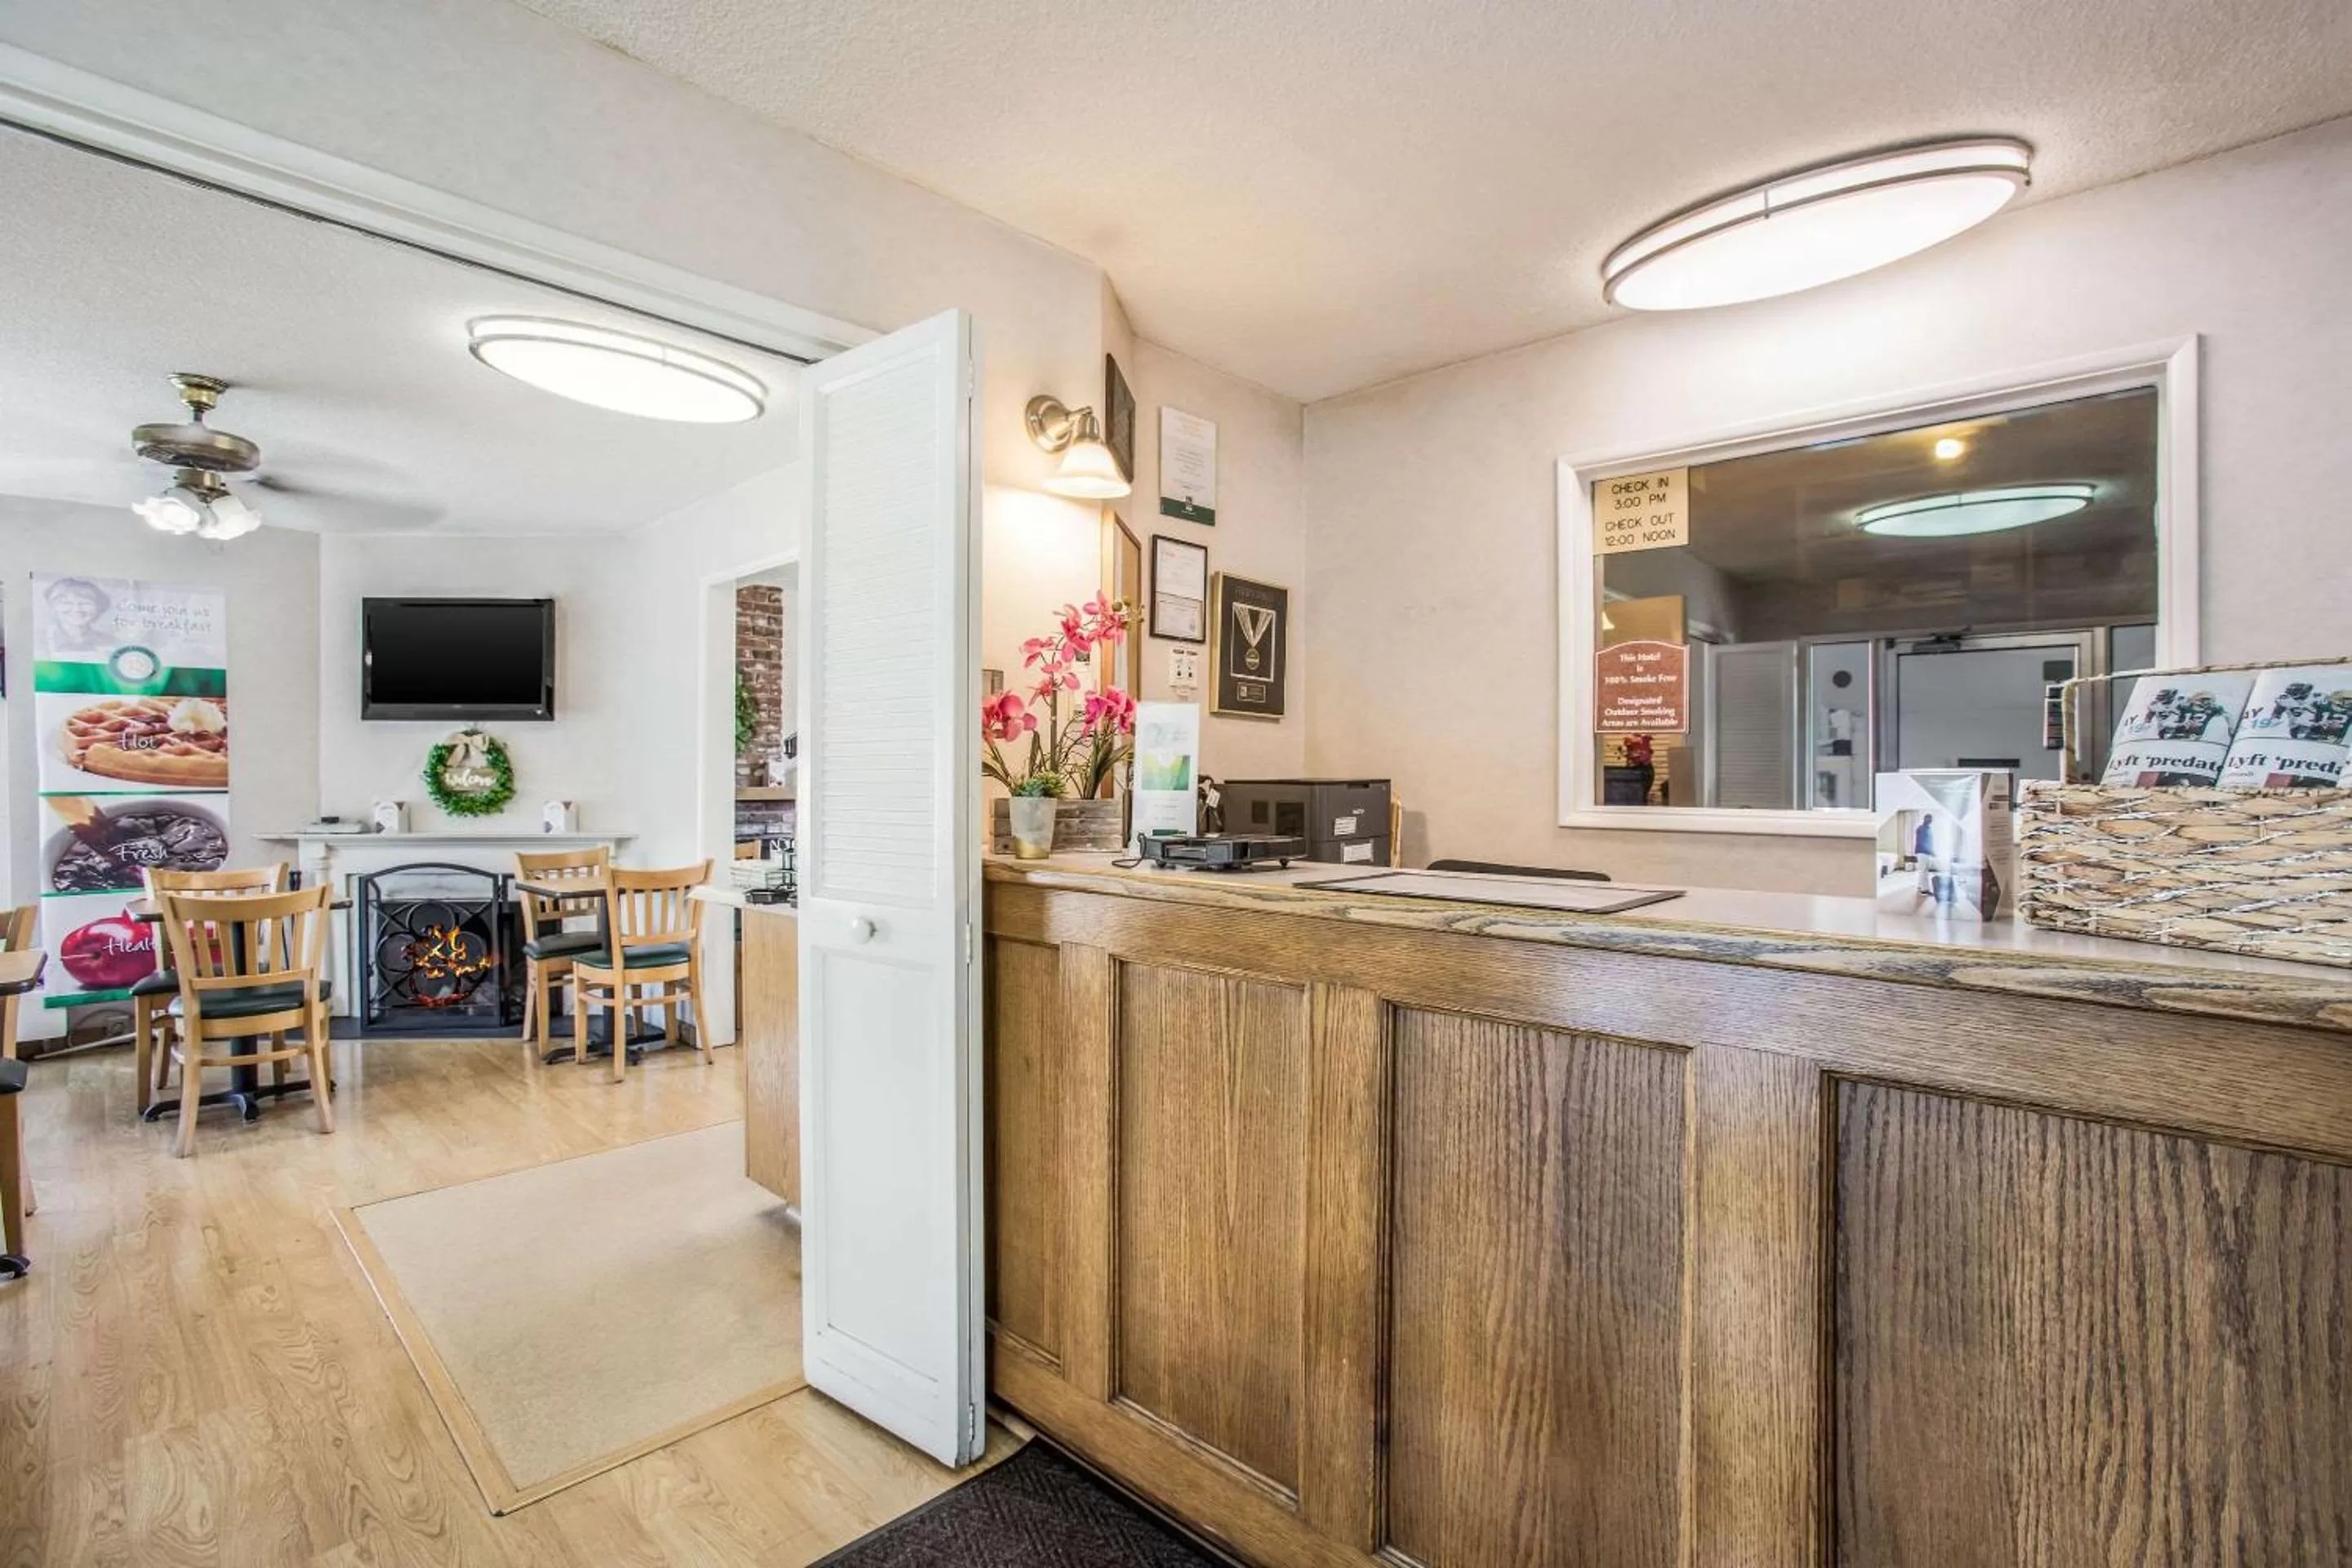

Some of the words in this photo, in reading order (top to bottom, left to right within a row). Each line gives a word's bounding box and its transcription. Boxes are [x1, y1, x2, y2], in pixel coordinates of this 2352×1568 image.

[1611, 480, 1649, 495] CHECK
[1658, 477, 1669, 488] IN
[1649, 492, 1666, 506] PM
[1605, 517, 1642, 532] CHECK
[1650, 513, 1675, 525] OUT
[1642, 529, 1676, 542] NOON
[1619, 653, 1636, 662] This
[1629, 675, 1657, 684] Smoke
[1658, 674, 1677, 683] Free
[1617, 696, 1663, 706] Designated
[1604, 708, 1639, 716] Outdoor
[1641, 706, 1676, 717] Smoking
[1602, 719, 1624, 727] Areas
[1640, 718, 1678, 727] Available
[118, 733, 158, 751] Hot
[109, 844, 167, 862] Fresh
[103, 938, 155, 956] Heal
